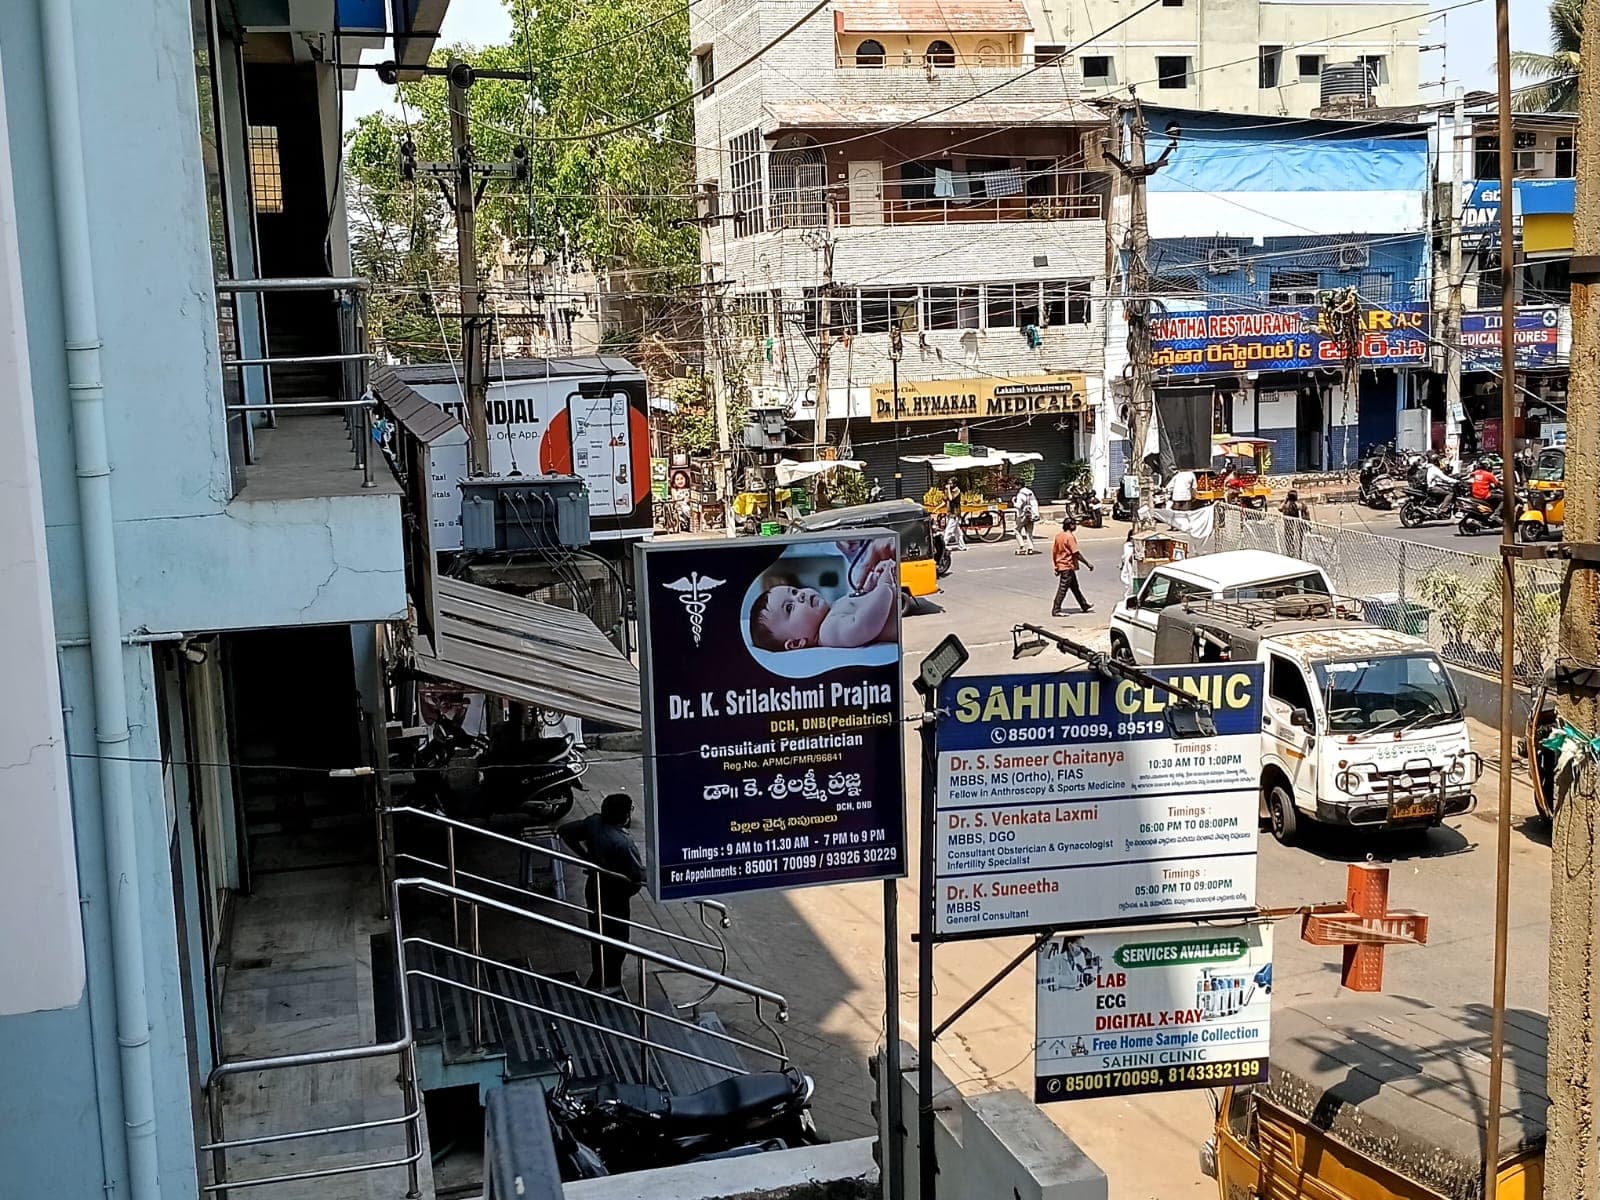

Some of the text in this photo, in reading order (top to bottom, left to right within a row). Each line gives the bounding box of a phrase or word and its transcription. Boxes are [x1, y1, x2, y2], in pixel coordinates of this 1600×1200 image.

[1208, 312, 1301, 338] RESTAURANT
[913, 394, 977, 412] HYMAKAR
[987, 393, 1082, 415] MEDICALS
[669, 681, 891, 720] Dr. K. Srilakshmi Prajna
[956, 673, 1252, 724] SAHINI CLINIC
[770, 711, 892, 733] DCH, DNB(Pediatrics)
[1008, 719, 1164, 742] 85001 70099, 89519
[700, 733, 863, 759] Consultant Pediatrician
[950, 749, 1124, 772] Dr. S. Sameer Chaitanya
[1148, 754, 1242, 770] 10:30 AM TO 1:00PM
[950, 774, 988, 788] MBBS,
[991, 772, 1008, 784] MS
[1057, 768, 1084, 780] FIAS
[950, 788, 978, 799] Fellow
[980, 788, 988, 798] in
[991, 785, 1047, 798] Anthroscopy
[1048, 784, 1055, 793] &
[1057, 781, 1086, 795] Sports
[1088, 780, 1126, 791] Medicine
[856, 800, 872, 810] DNB
[949, 805, 1099, 829] Dr. S. Venkata Laxmi
[1140, 817, 1238, 834] 06:00 PM TO 08:00PM
[727, 844, 733, 855] 9
[735, 842, 750, 854] AM
[753, 841, 762, 853] to
[765, 838, 792, 852] 11.30
[794, 836, 809, 849] AM
[824, 834, 830, 846] 7
[832, 832, 848, 845] PM
[850, 831, 859, 843] to
[861, 831, 868, 842] 9
[870, 828, 885, 841] PM
[949, 830, 1016, 847] MBBS, DGO
[948, 847, 995, 860] Consultant
[1048, 843, 1055, 852] &
[1057, 839, 1114, 853] Gynacologist
[671, 870, 683, 883] For
[685, 864, 737, 883] Appointments
[745, 859, 779, 874] 85001
[782, 855, 817, 871] 70099
[826, 851, 860, 866] 93926
[863, 847, 897, 863] 30229
[947, 856, 1030, 871] Infertility Specialist
[947, 880, 1060, 901] Dr. K. Suneetha
[1135, 878, 1233, 896] 05:00 PM TO 09:00PM
[946, 901, 981, 914] MBBS
[946, 909, 1029, 925] General Consultant
[1122, 942, 1240, 963] SERVICES AVAILABLE
[1097, 972, 1127, 989] LAB
[1096, 994, 1126, 1010] ECG
[1096, 1008, 1204, 1031] DIGITAL X-RAY
[1093, 1026, 1259, 1051] Free Home Sample Collection
[1102, 1049, 1207, 1069] SAHINI CLINIC
[1066, 1061, 1259, 1092] 8500170099, 8143332199
